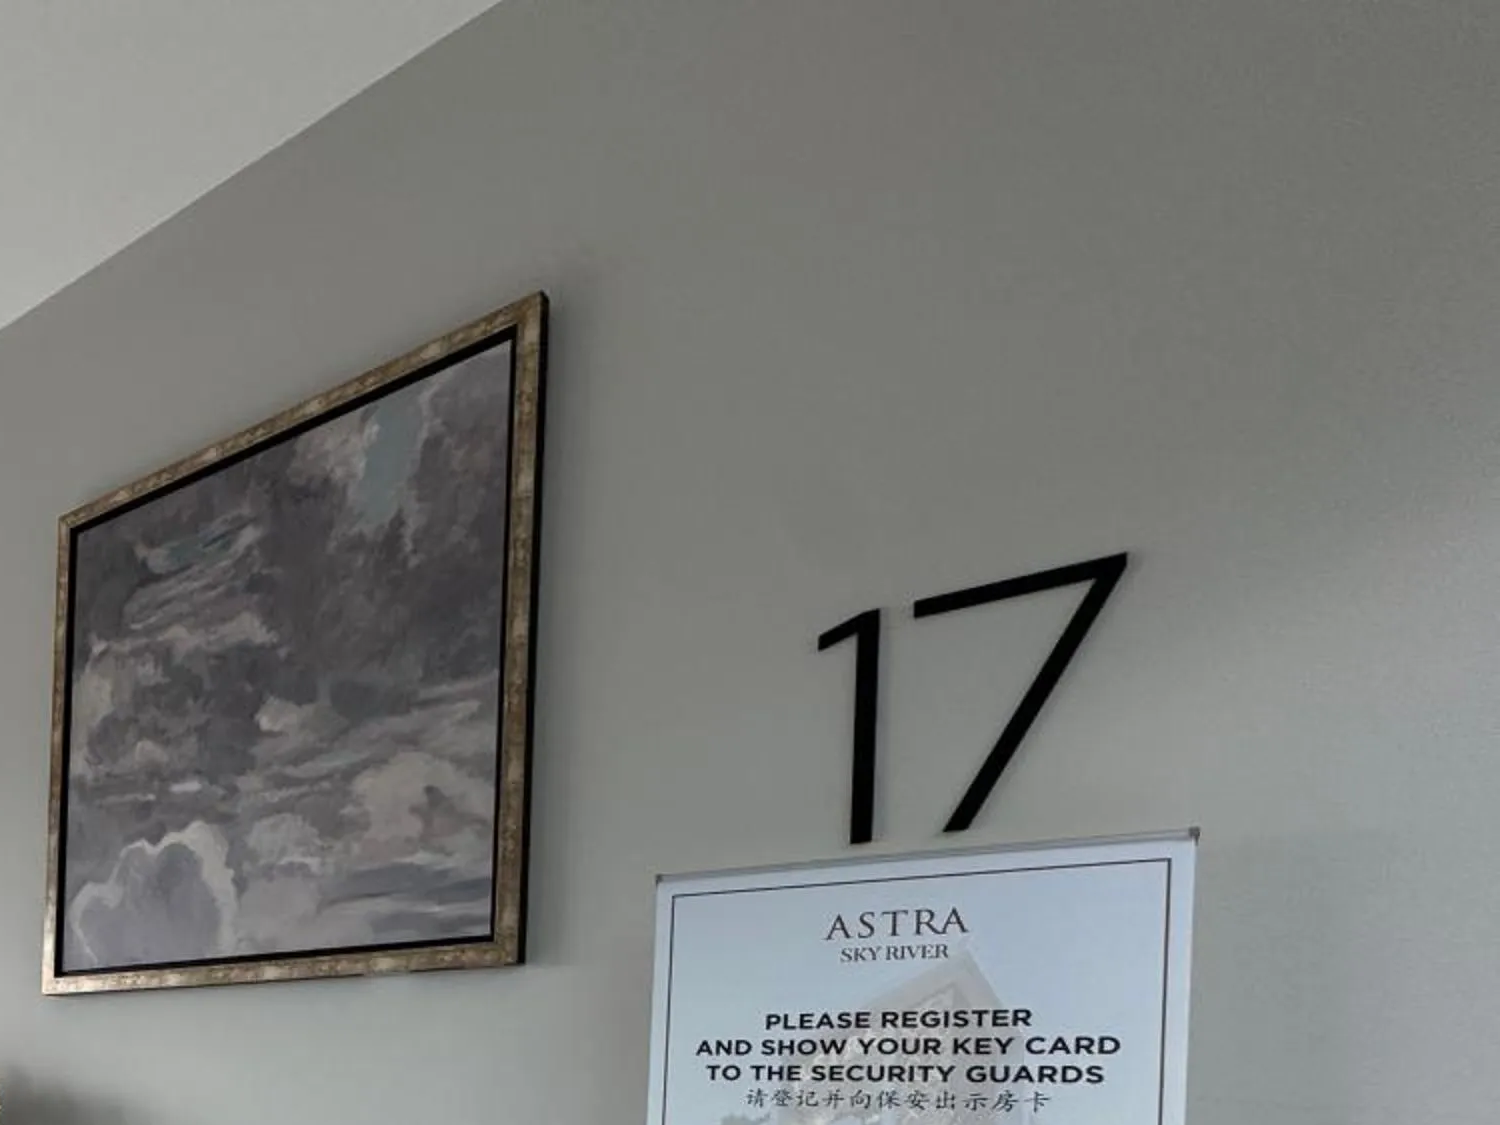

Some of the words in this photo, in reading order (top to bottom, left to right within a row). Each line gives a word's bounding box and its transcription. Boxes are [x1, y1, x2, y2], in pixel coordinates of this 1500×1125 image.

[818, 552, 1127, 844] 17
[822, 906, 969, 941] ASTRA
[840, 946, 881, 963] SKY
[885, 943, 949, 961] RIVER
[765, 1010, 871, 1030] PLEASE
[881, 1008, 1032, 1028] REGISTER
[696, 1038, 752, 1056] AND
[761, 1038, 847, 1056] SHOW
[856, 1037, 941, 1056] YOUR
[953, 1036, 1015, 1056] KEY
[1026, 1036, 1122, 1055] CARD
[707, 1065, 741, 1082] TO
[750, 1065, 801, 1082] THE
[811, 1064, 956, 1083] SECURITY
[966, 1065, 1106, 1084] GUARDS
[746, 1088, 1051, 1114] 请登记并向保安出示房卡
